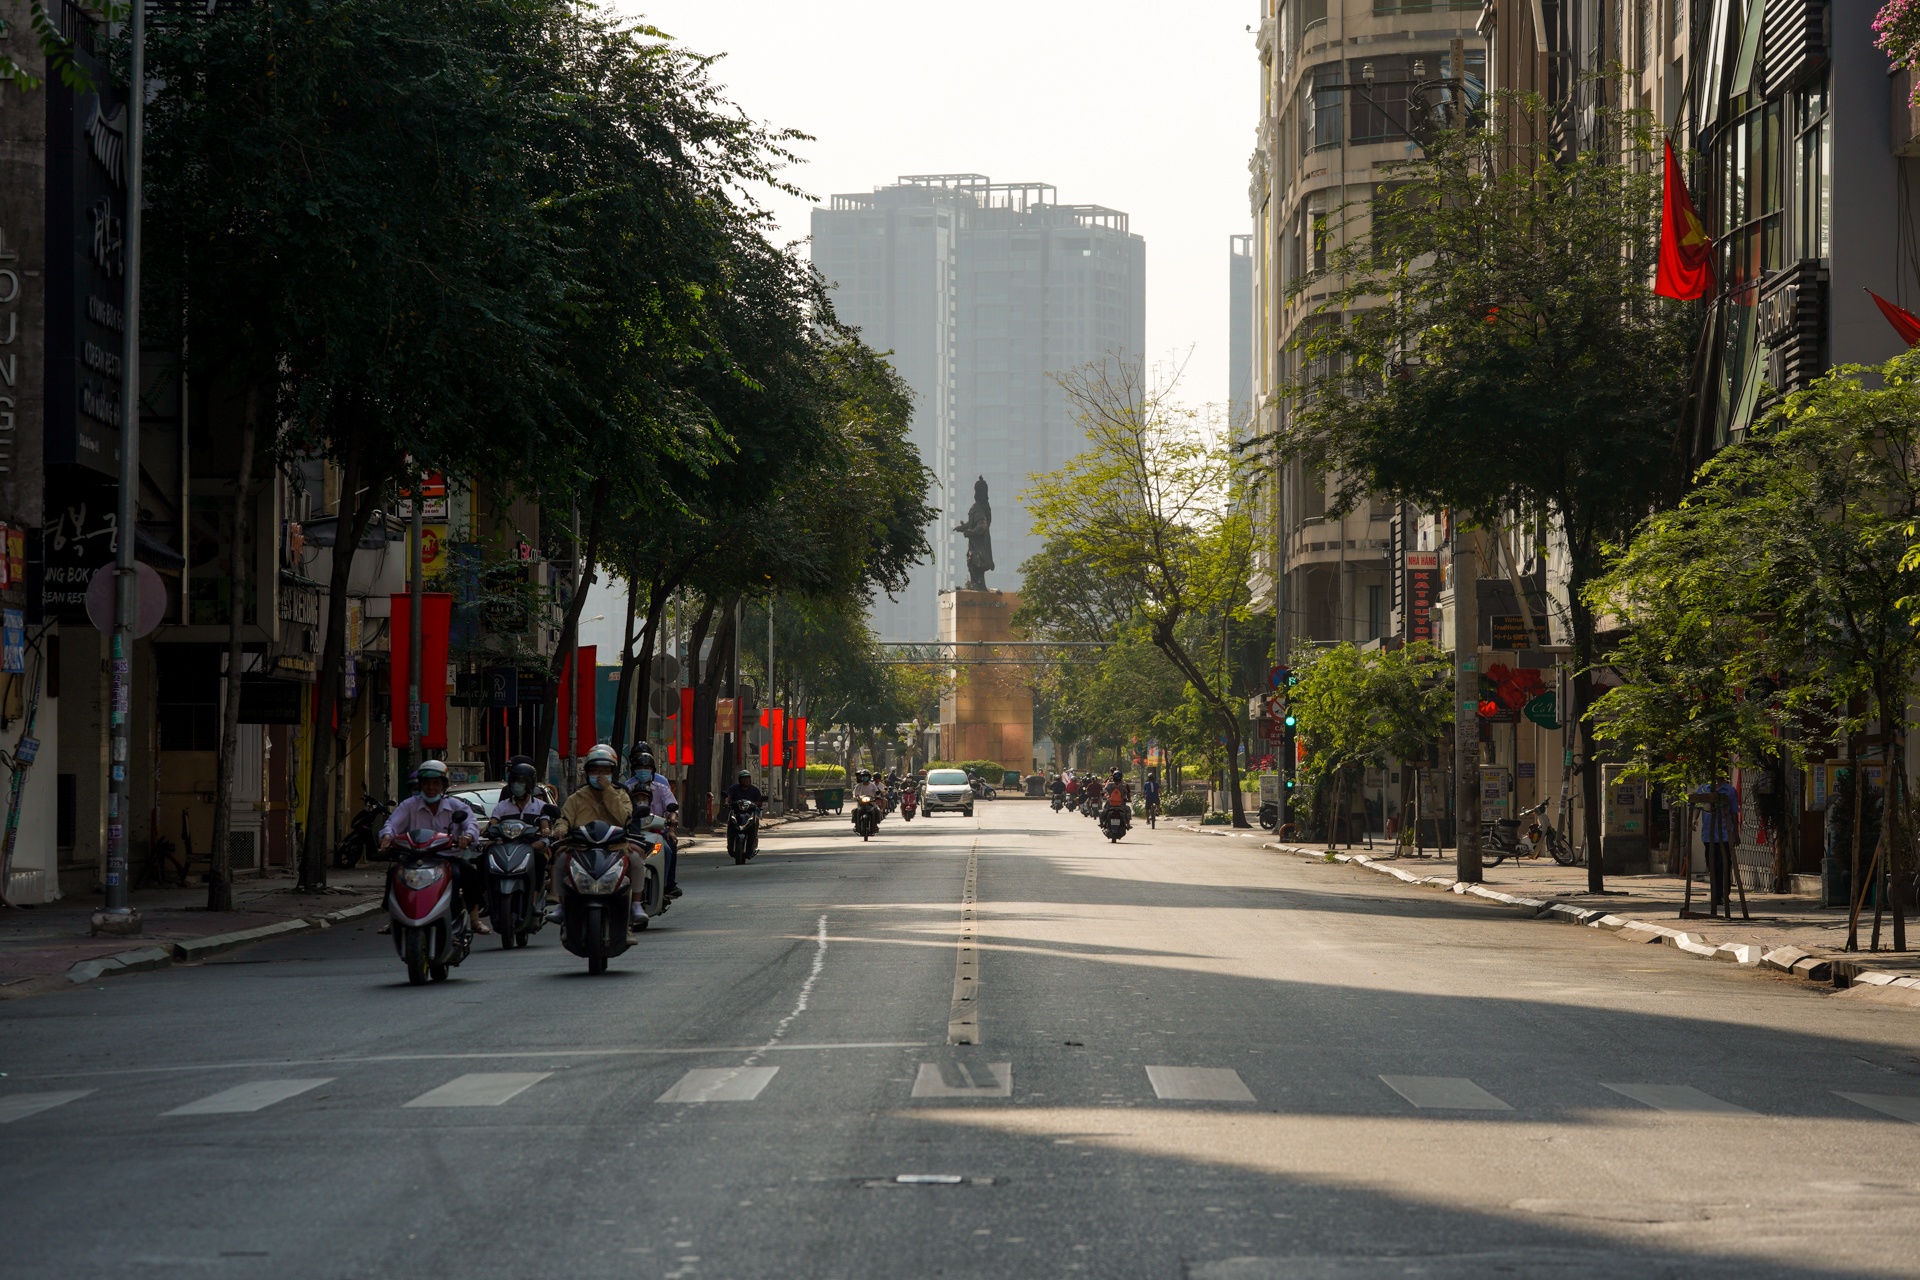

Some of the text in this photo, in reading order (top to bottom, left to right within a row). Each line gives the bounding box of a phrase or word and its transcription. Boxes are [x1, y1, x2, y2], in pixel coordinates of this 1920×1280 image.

[1408, 554, 1437, 566] NHÀ HÀNG
[68, 566, 91, 584] BOK
